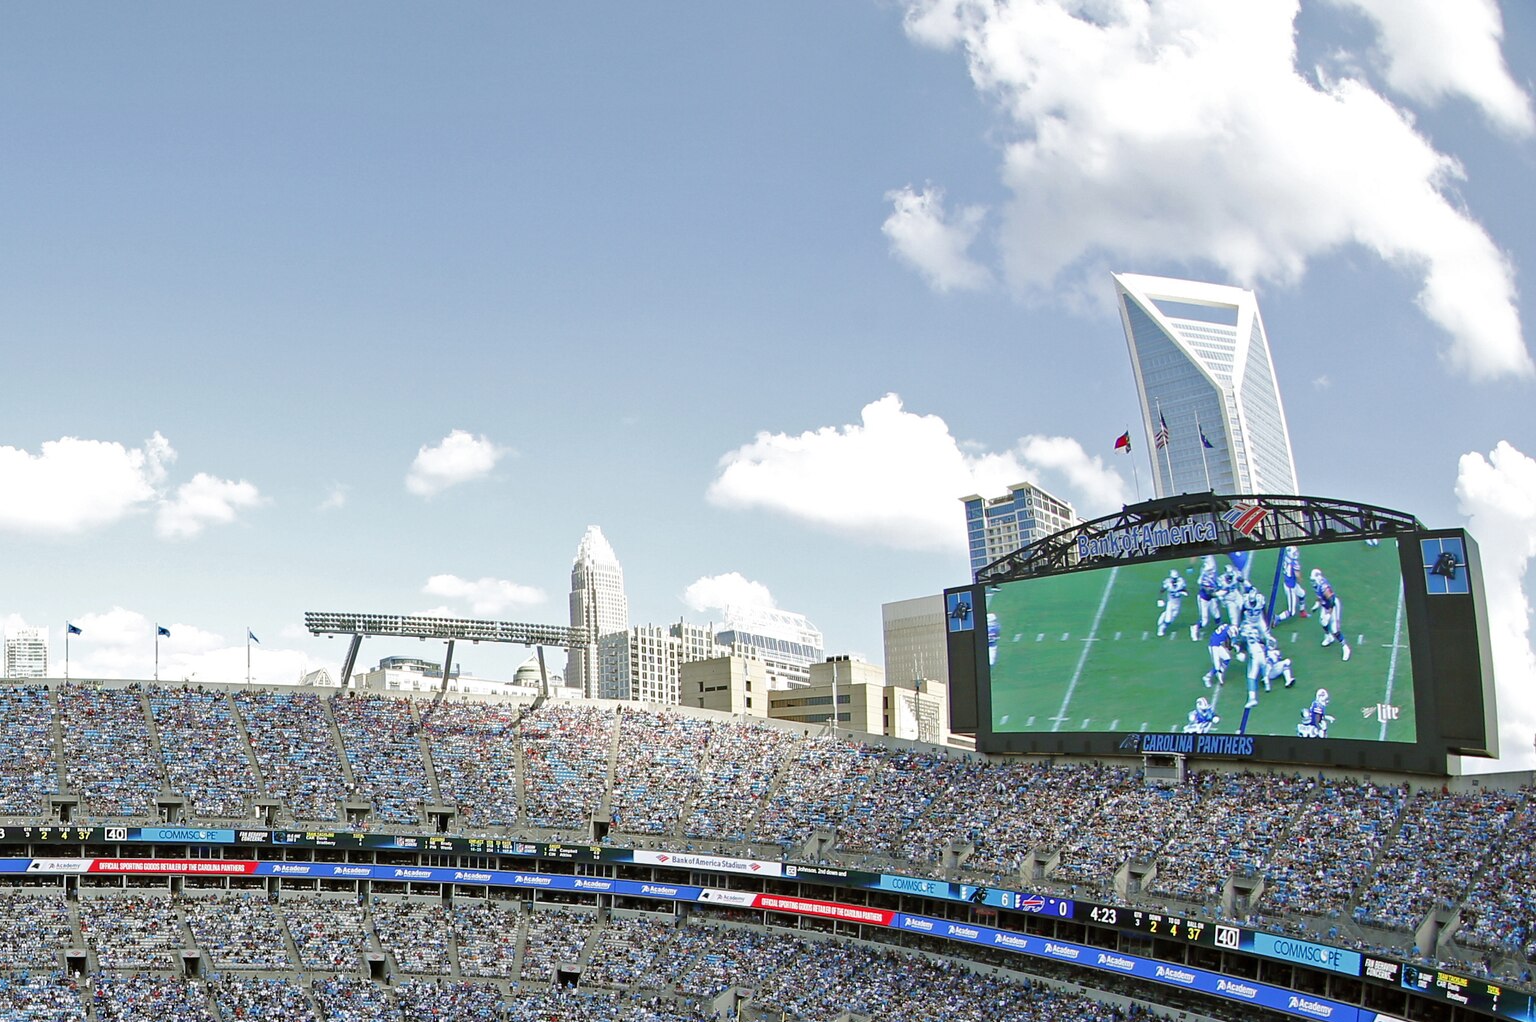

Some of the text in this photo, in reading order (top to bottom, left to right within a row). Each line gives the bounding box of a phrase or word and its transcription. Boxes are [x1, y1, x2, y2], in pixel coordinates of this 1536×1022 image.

[1077, 517, 1217, 559] Bank of America
[1377, 703, 1399, 722] Lite
[1142, 734, 1255, 755] CAROLINA PANTHERS
[41, 832, 48, 840] 2
[61, 832, 68, 840] 4
[78, 831, 90, 840] 37
[108, 830, 124, 840] 40
[159, 830, 216, 840] COMMSCOPE
[99, 862, 120, 870] OFFICIAL
[120, 862, 143, 870] SPORTING
[144, 862, 160, 870] GOODS
[160, 862, 182, 870] RETAILER
[198, 863, 220, 871] CAROLINA
[221, 864, 245, 872] PANTHERS
[672, 855, 688, 864] Bank
[695, 858, 720, 867] America
[721, 861, 747, 870] Stadium
[464, 873, 492, 881] Academy
[892, 879, 934, 893] COMMSCOPE
[1001, 895, 1008, 906] 6
[1059, 902, 1067, 916] 0
[1090, 907, 1116, 924] 4:23
[1150, 922, 1157, 932] 2
[1170, 925, 1177, 936] 4
[1188, 928, 1200, 940] 37
[1218, 930, 1236, 946] 40
[1053, 944, 1080, 957] Academy
[1274, 940, 1340, 967] COMMSCOPE
[1165, 967, 1196, 980] Academy
[1227, 982, 1258, 996] Academy
[1298, 999, 1333, 1015] Academy
